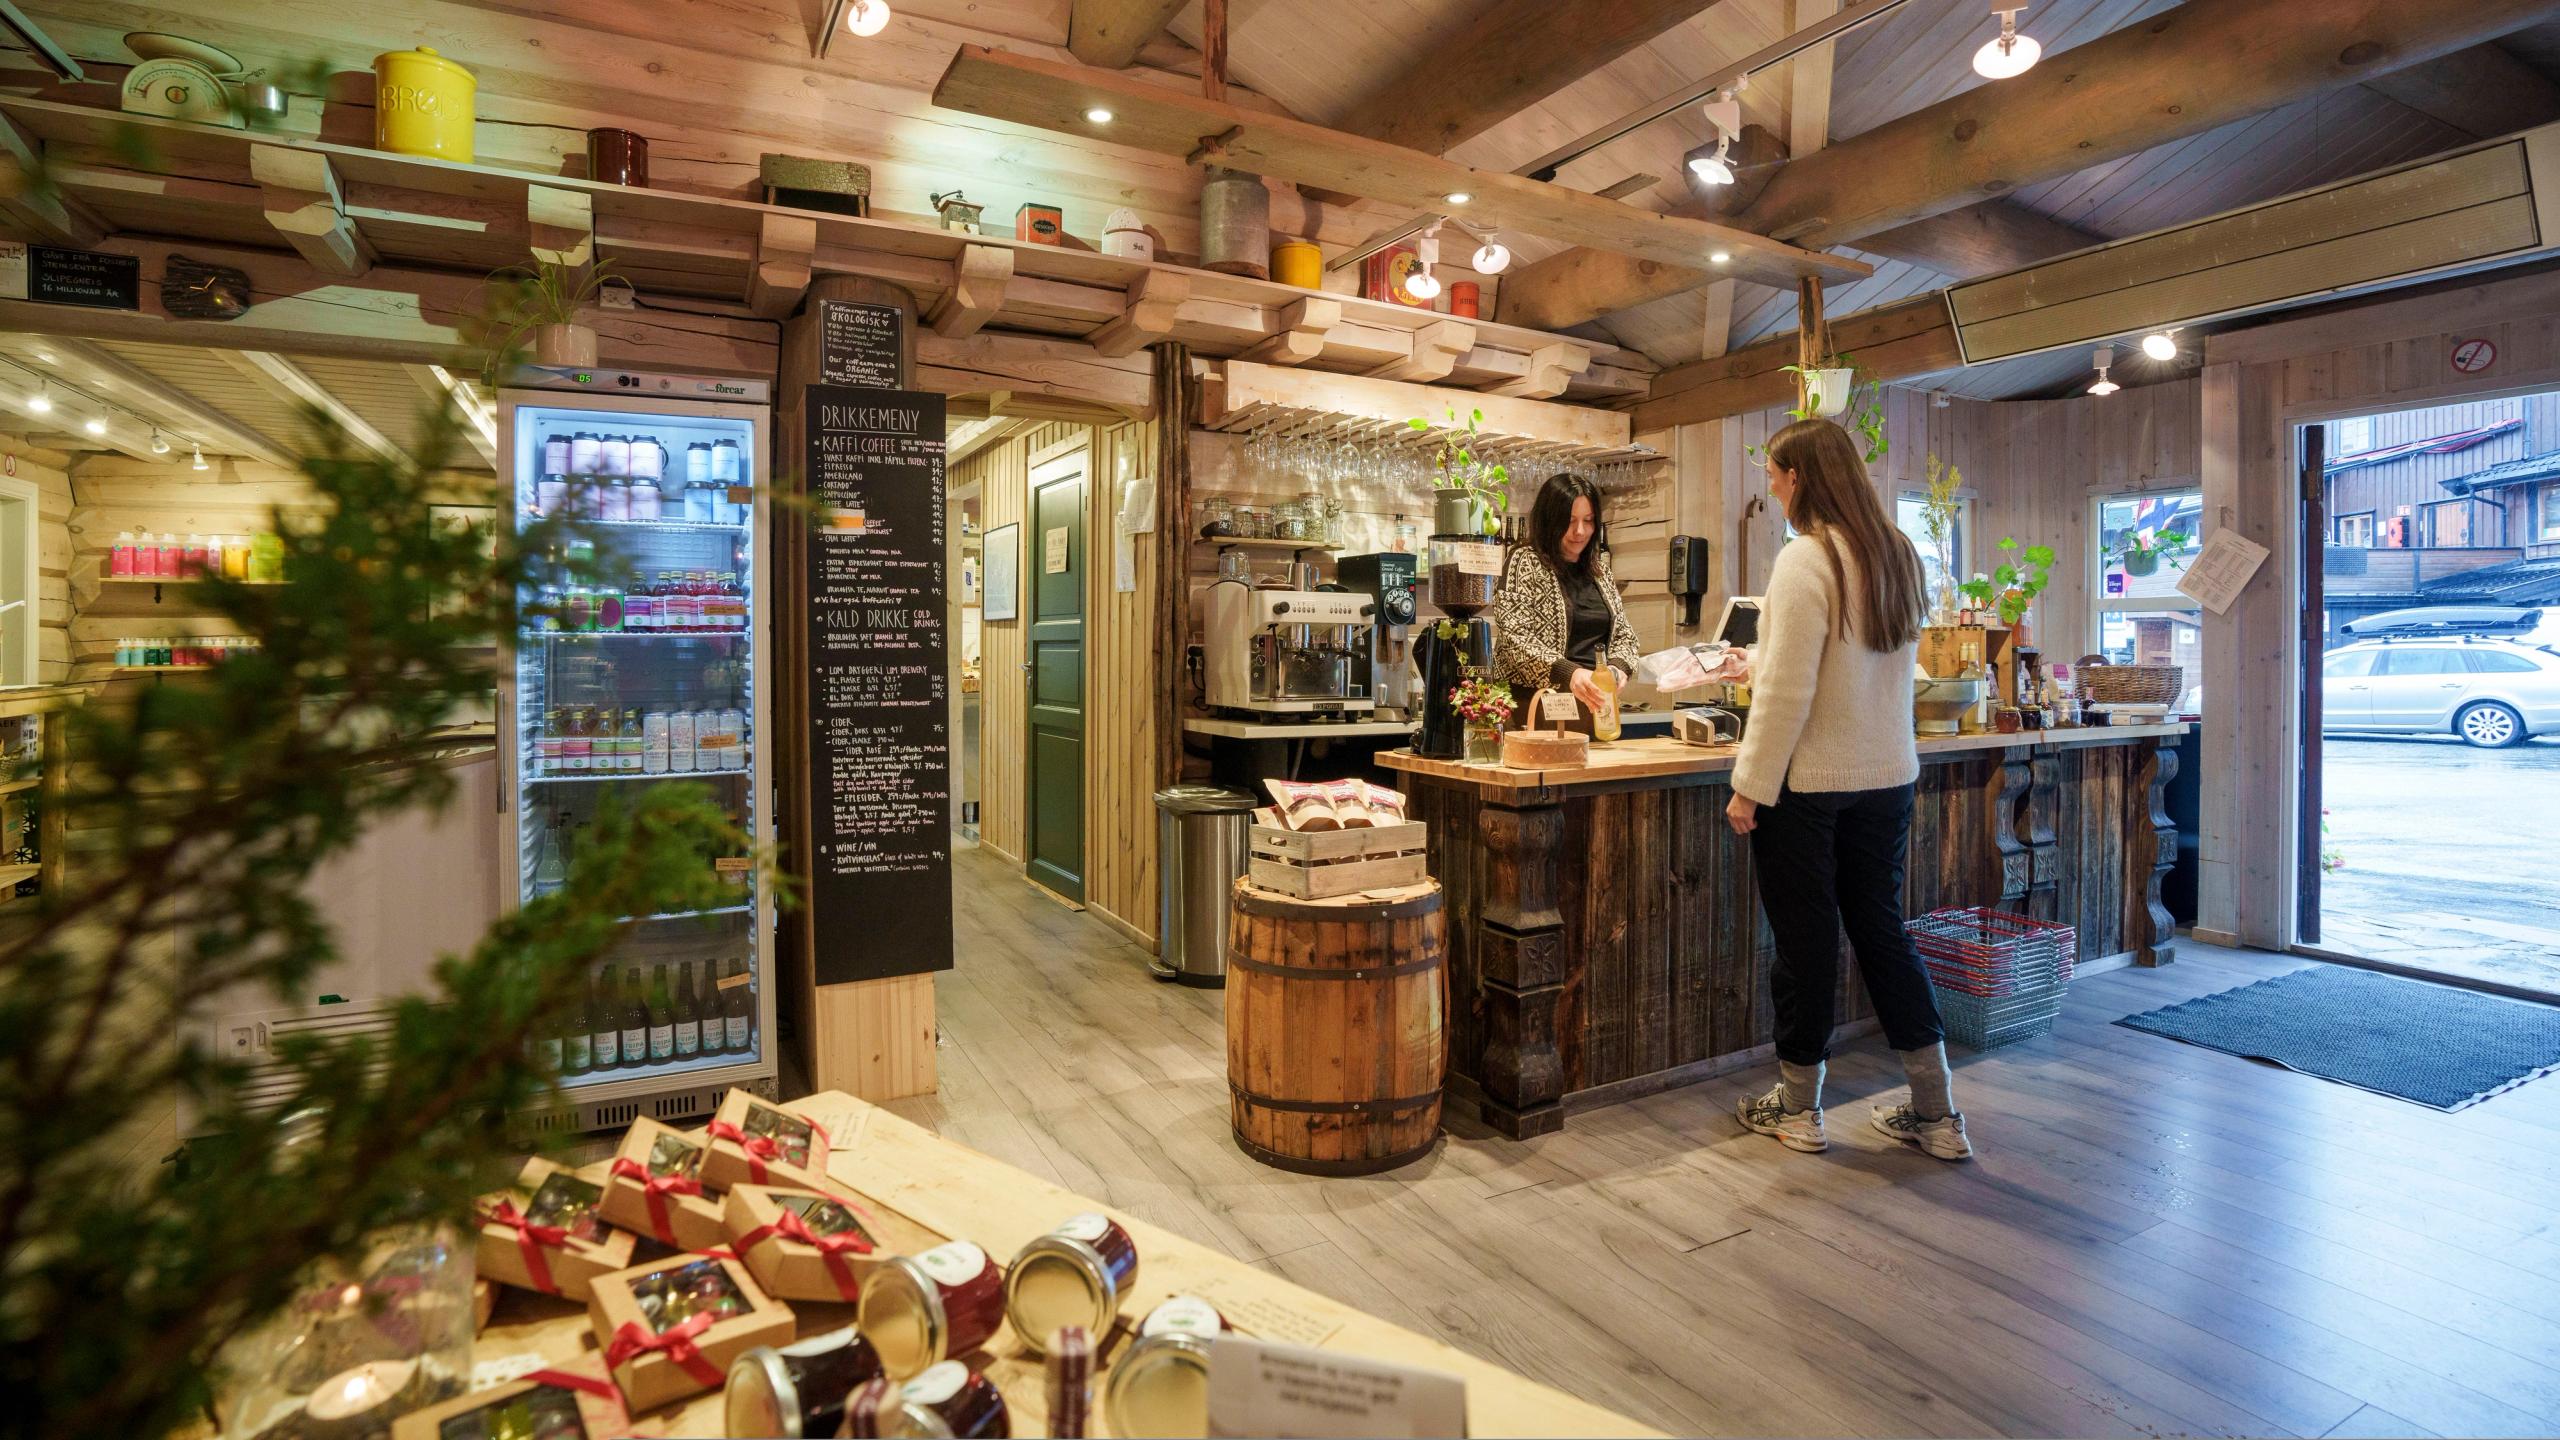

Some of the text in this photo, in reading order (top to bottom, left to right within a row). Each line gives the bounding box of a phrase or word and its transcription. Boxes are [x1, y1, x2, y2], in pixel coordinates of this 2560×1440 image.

[382, 85, 461, 121] BRØD
[42, 284, 53, 292] 16
[106, 288, 119, 298] ÅR
[831, 312, 880, 327] ØKOLOGISK
[846, 365, 879, 375] ORGANIC
[822, 405, 919, 432] DRIKKEMENY
[822, 435, 858, 452] KAFFI
[861, 438, 896, 454] COFFEE
[824, 454, 842, 462] SVART
[846, 454, 864, 462] KAFFI
[885, 456, 906, 465] PÅFYLL
[823, 471, 863, 480] AMERICANO
[830, 596, 842, 604] har
[843, 598, 860, 606] også
[827, 609, 910, 629] KALD DRIKKE
[913, 609, 931, 619] COLD
[913, 619, 940, 628] DRINKS
[829, 664, 928, 676] LOM BRYGGERI LOM BREWERY
[830, 717, 854, 727] CIDER
[845, 744, 882, 755] SIDER ROSÉ
[844, 793, 883, 802] EPLESIDER
[836, 842, 877, 852] WINE / VIN
